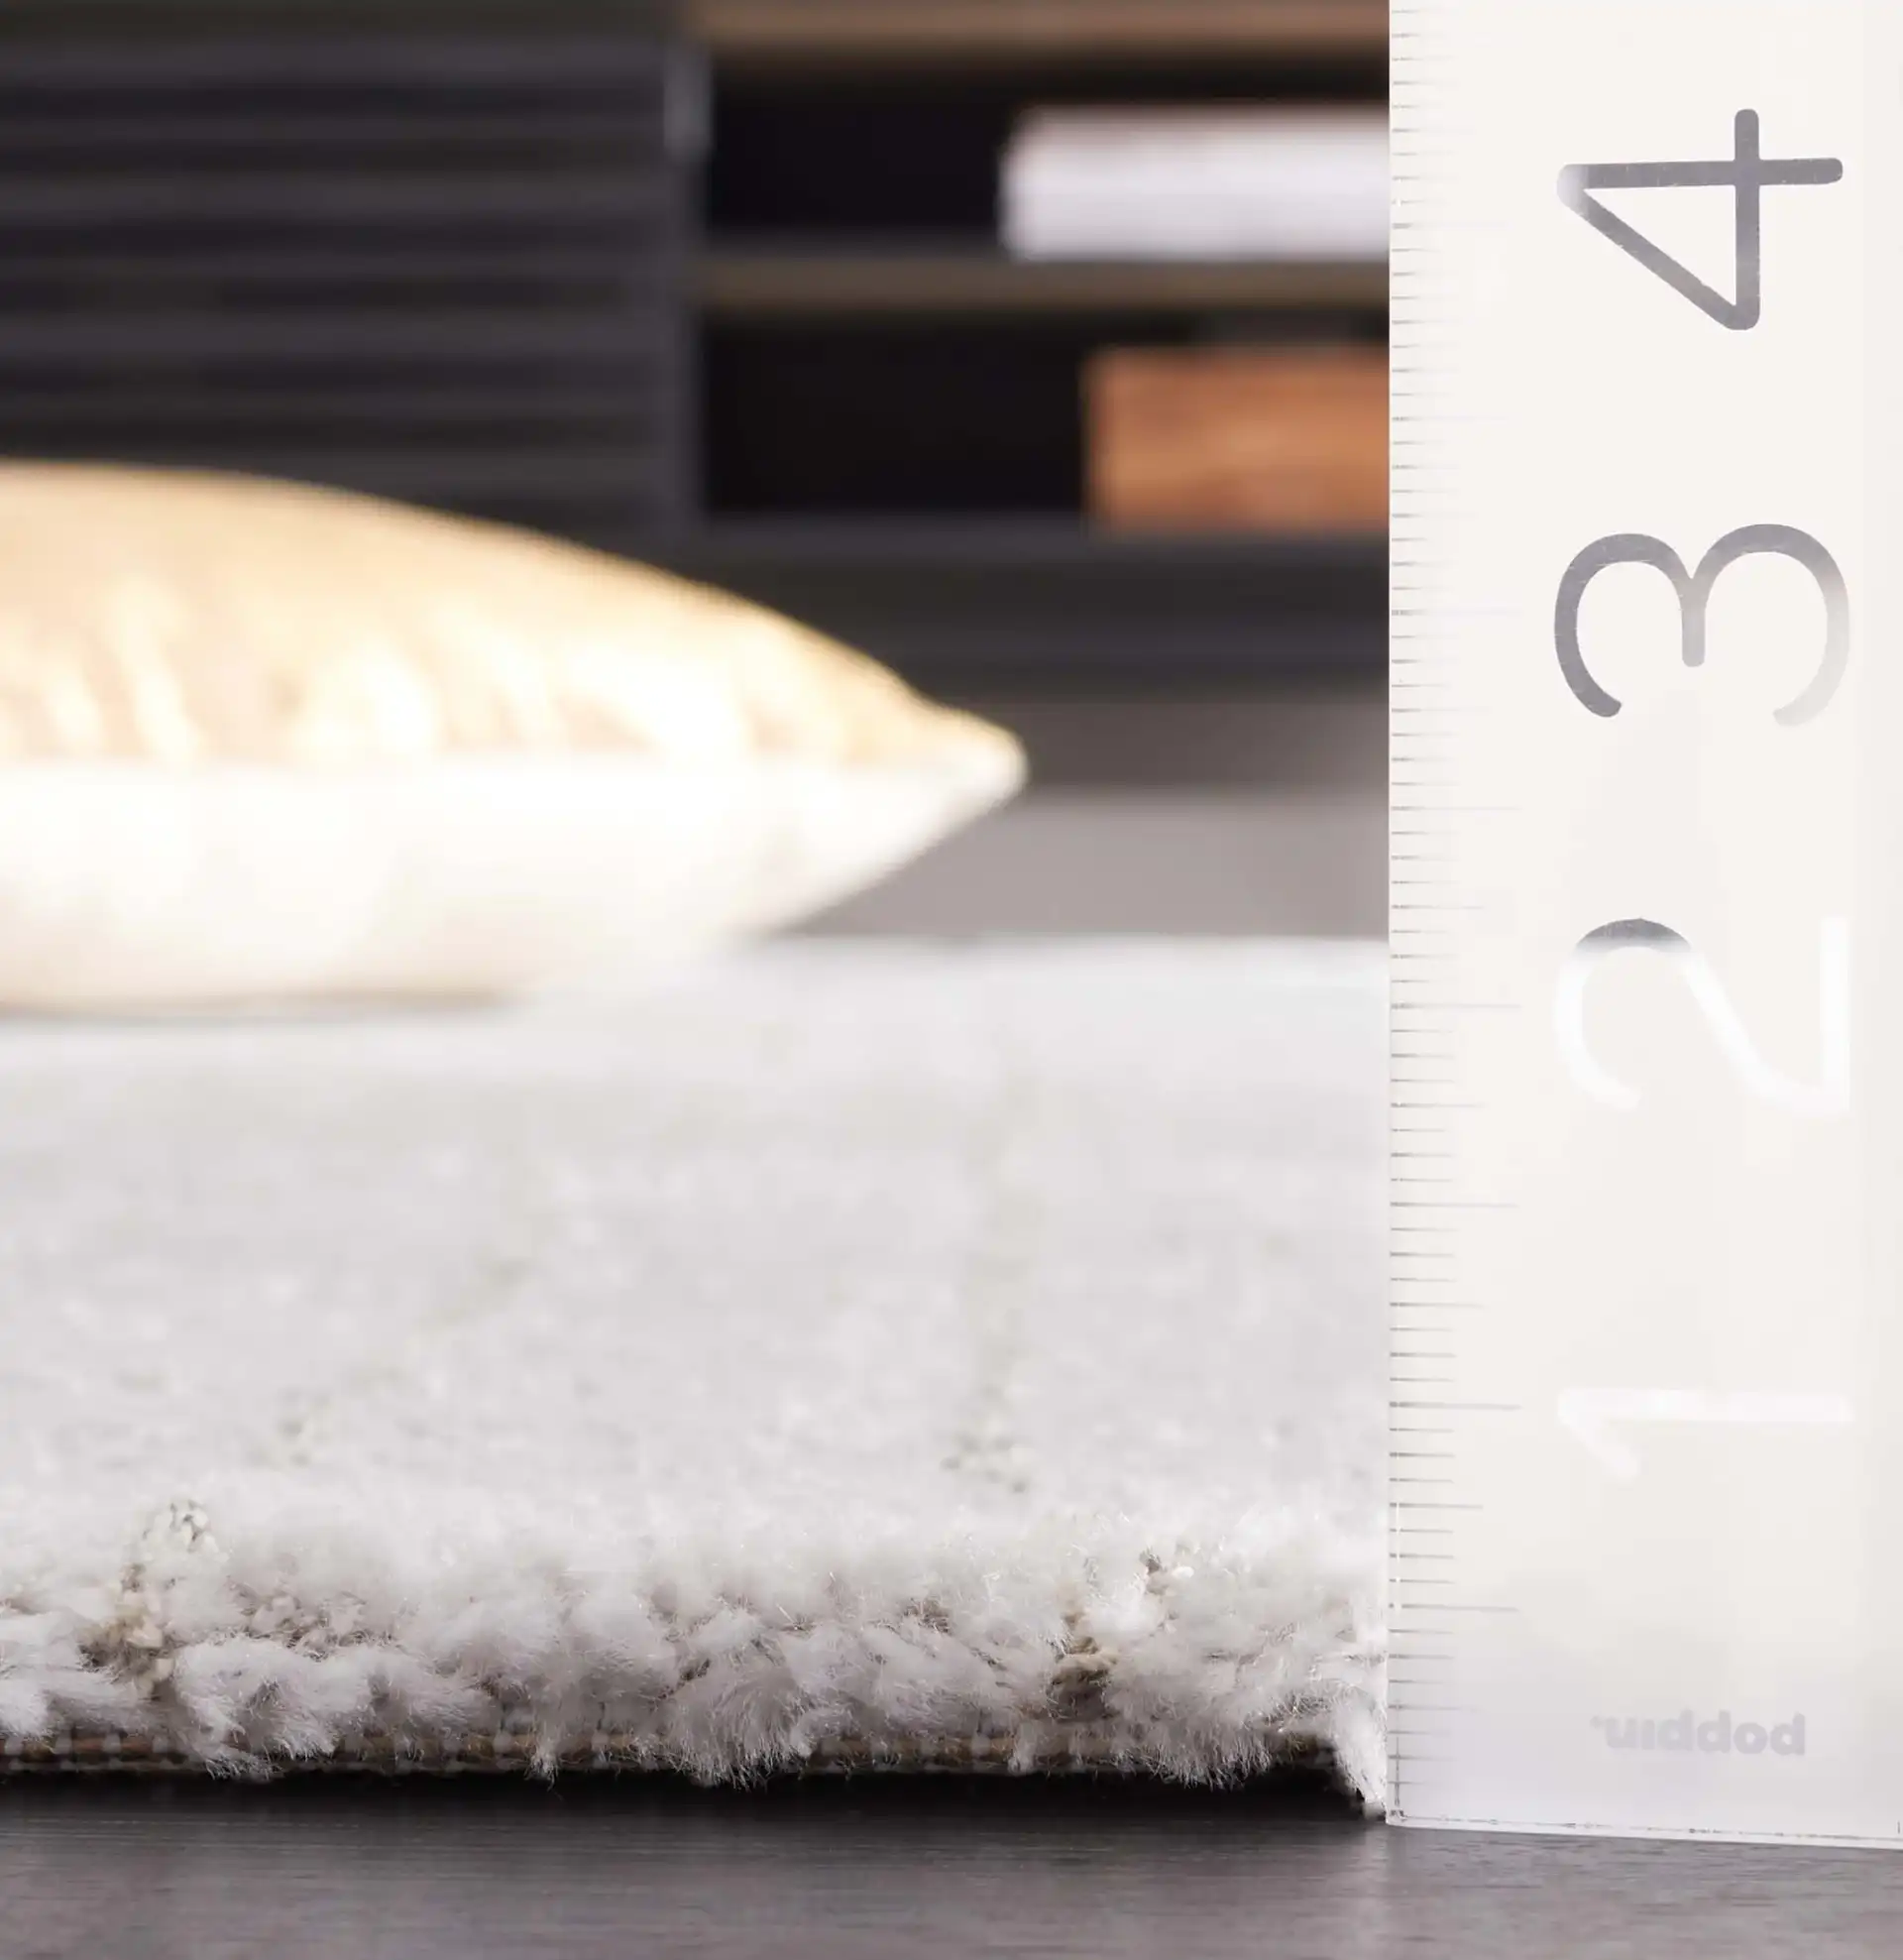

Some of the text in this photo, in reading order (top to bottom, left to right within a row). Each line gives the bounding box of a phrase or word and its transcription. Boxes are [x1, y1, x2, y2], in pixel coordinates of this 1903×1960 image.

[1556, 109, 1843, 330] 4
[1554, 523, 1849, 727] 3
[1554, 915, 1849, 1117] 2
[1558, 1388, 1853, 1483] 1
